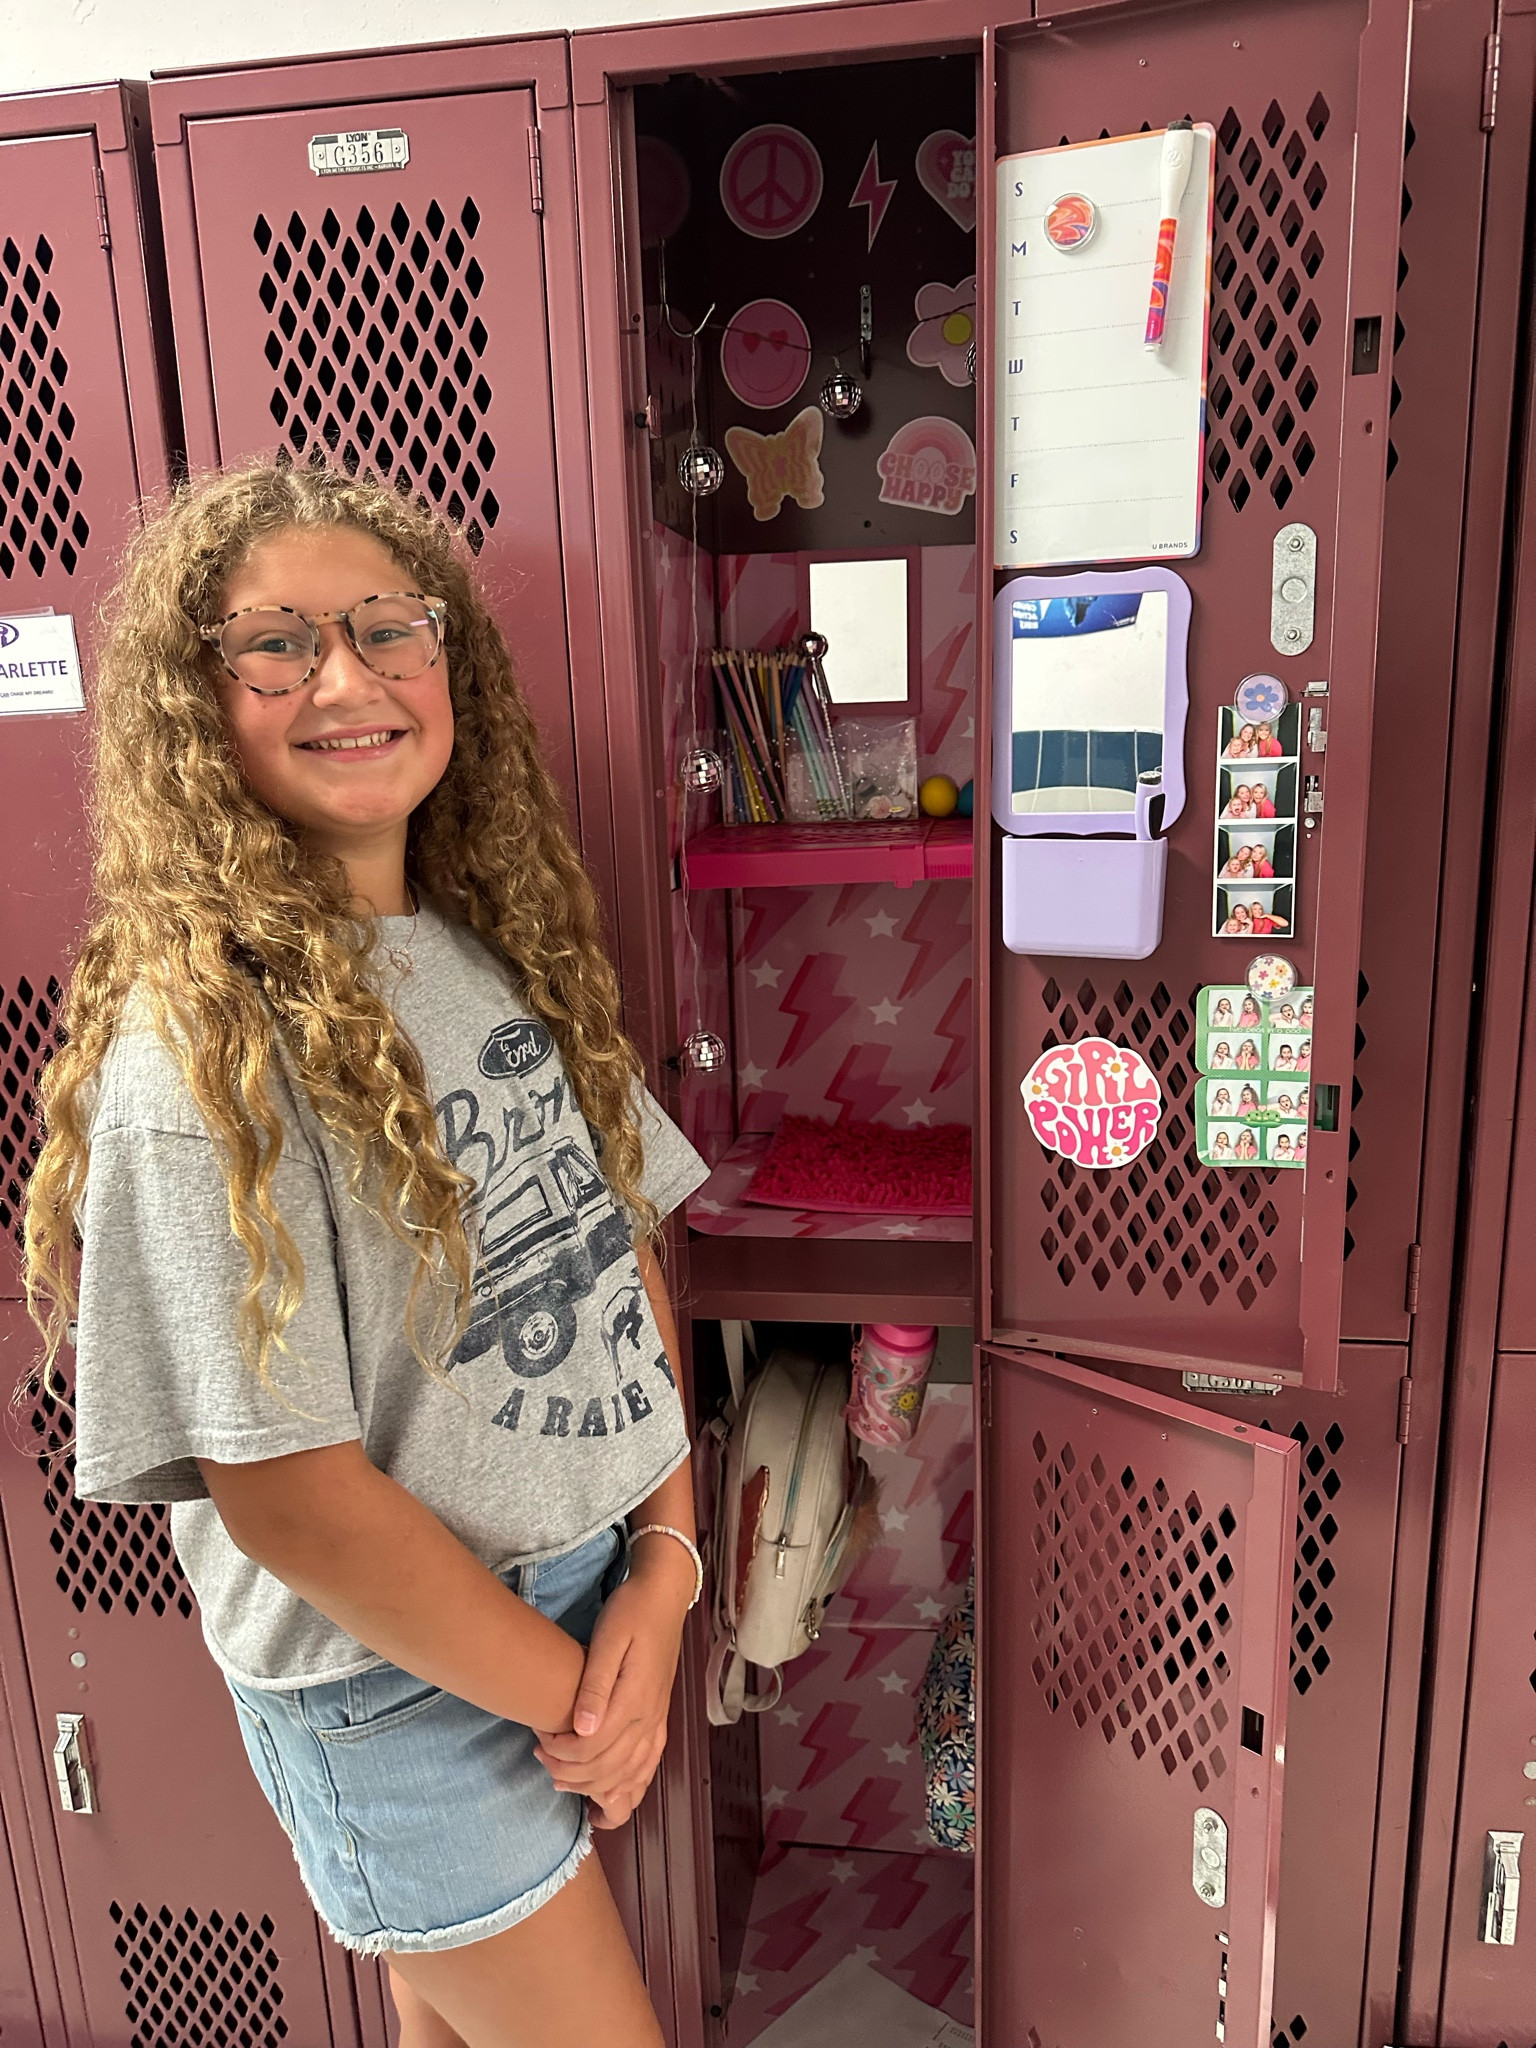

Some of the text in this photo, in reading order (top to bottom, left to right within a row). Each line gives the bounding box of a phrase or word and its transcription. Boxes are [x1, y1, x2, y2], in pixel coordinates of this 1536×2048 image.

[346, 132, 368, 143] LYON
[334, 142, 384, 166] G356
[951, 150, 976, 167] YO
[950, 166, 976, 182] CA
[1015, 182, 1023, 197] S
[1011, 241, 1027, 258] M
[1012, 301, 1022, 316] T
[1008, 359, 1024, 375] W
[1011, 417, 1020, 431] T
[880, 452, 976, 491] CHOOSE
[1011, 474, 1019, 488] F
[881, 476, 963, 511] HAPPY
[1010, 530, 1018, 544] S
[1158, 541, 1188, 550] BRANDS
[495, 1028, 543, 1068] Ford
[1032, 1041, 1158, 1107] GIRL
[1028, 1102, 1159, 1166] POWER
[490, 1387, 526, 1432] A
